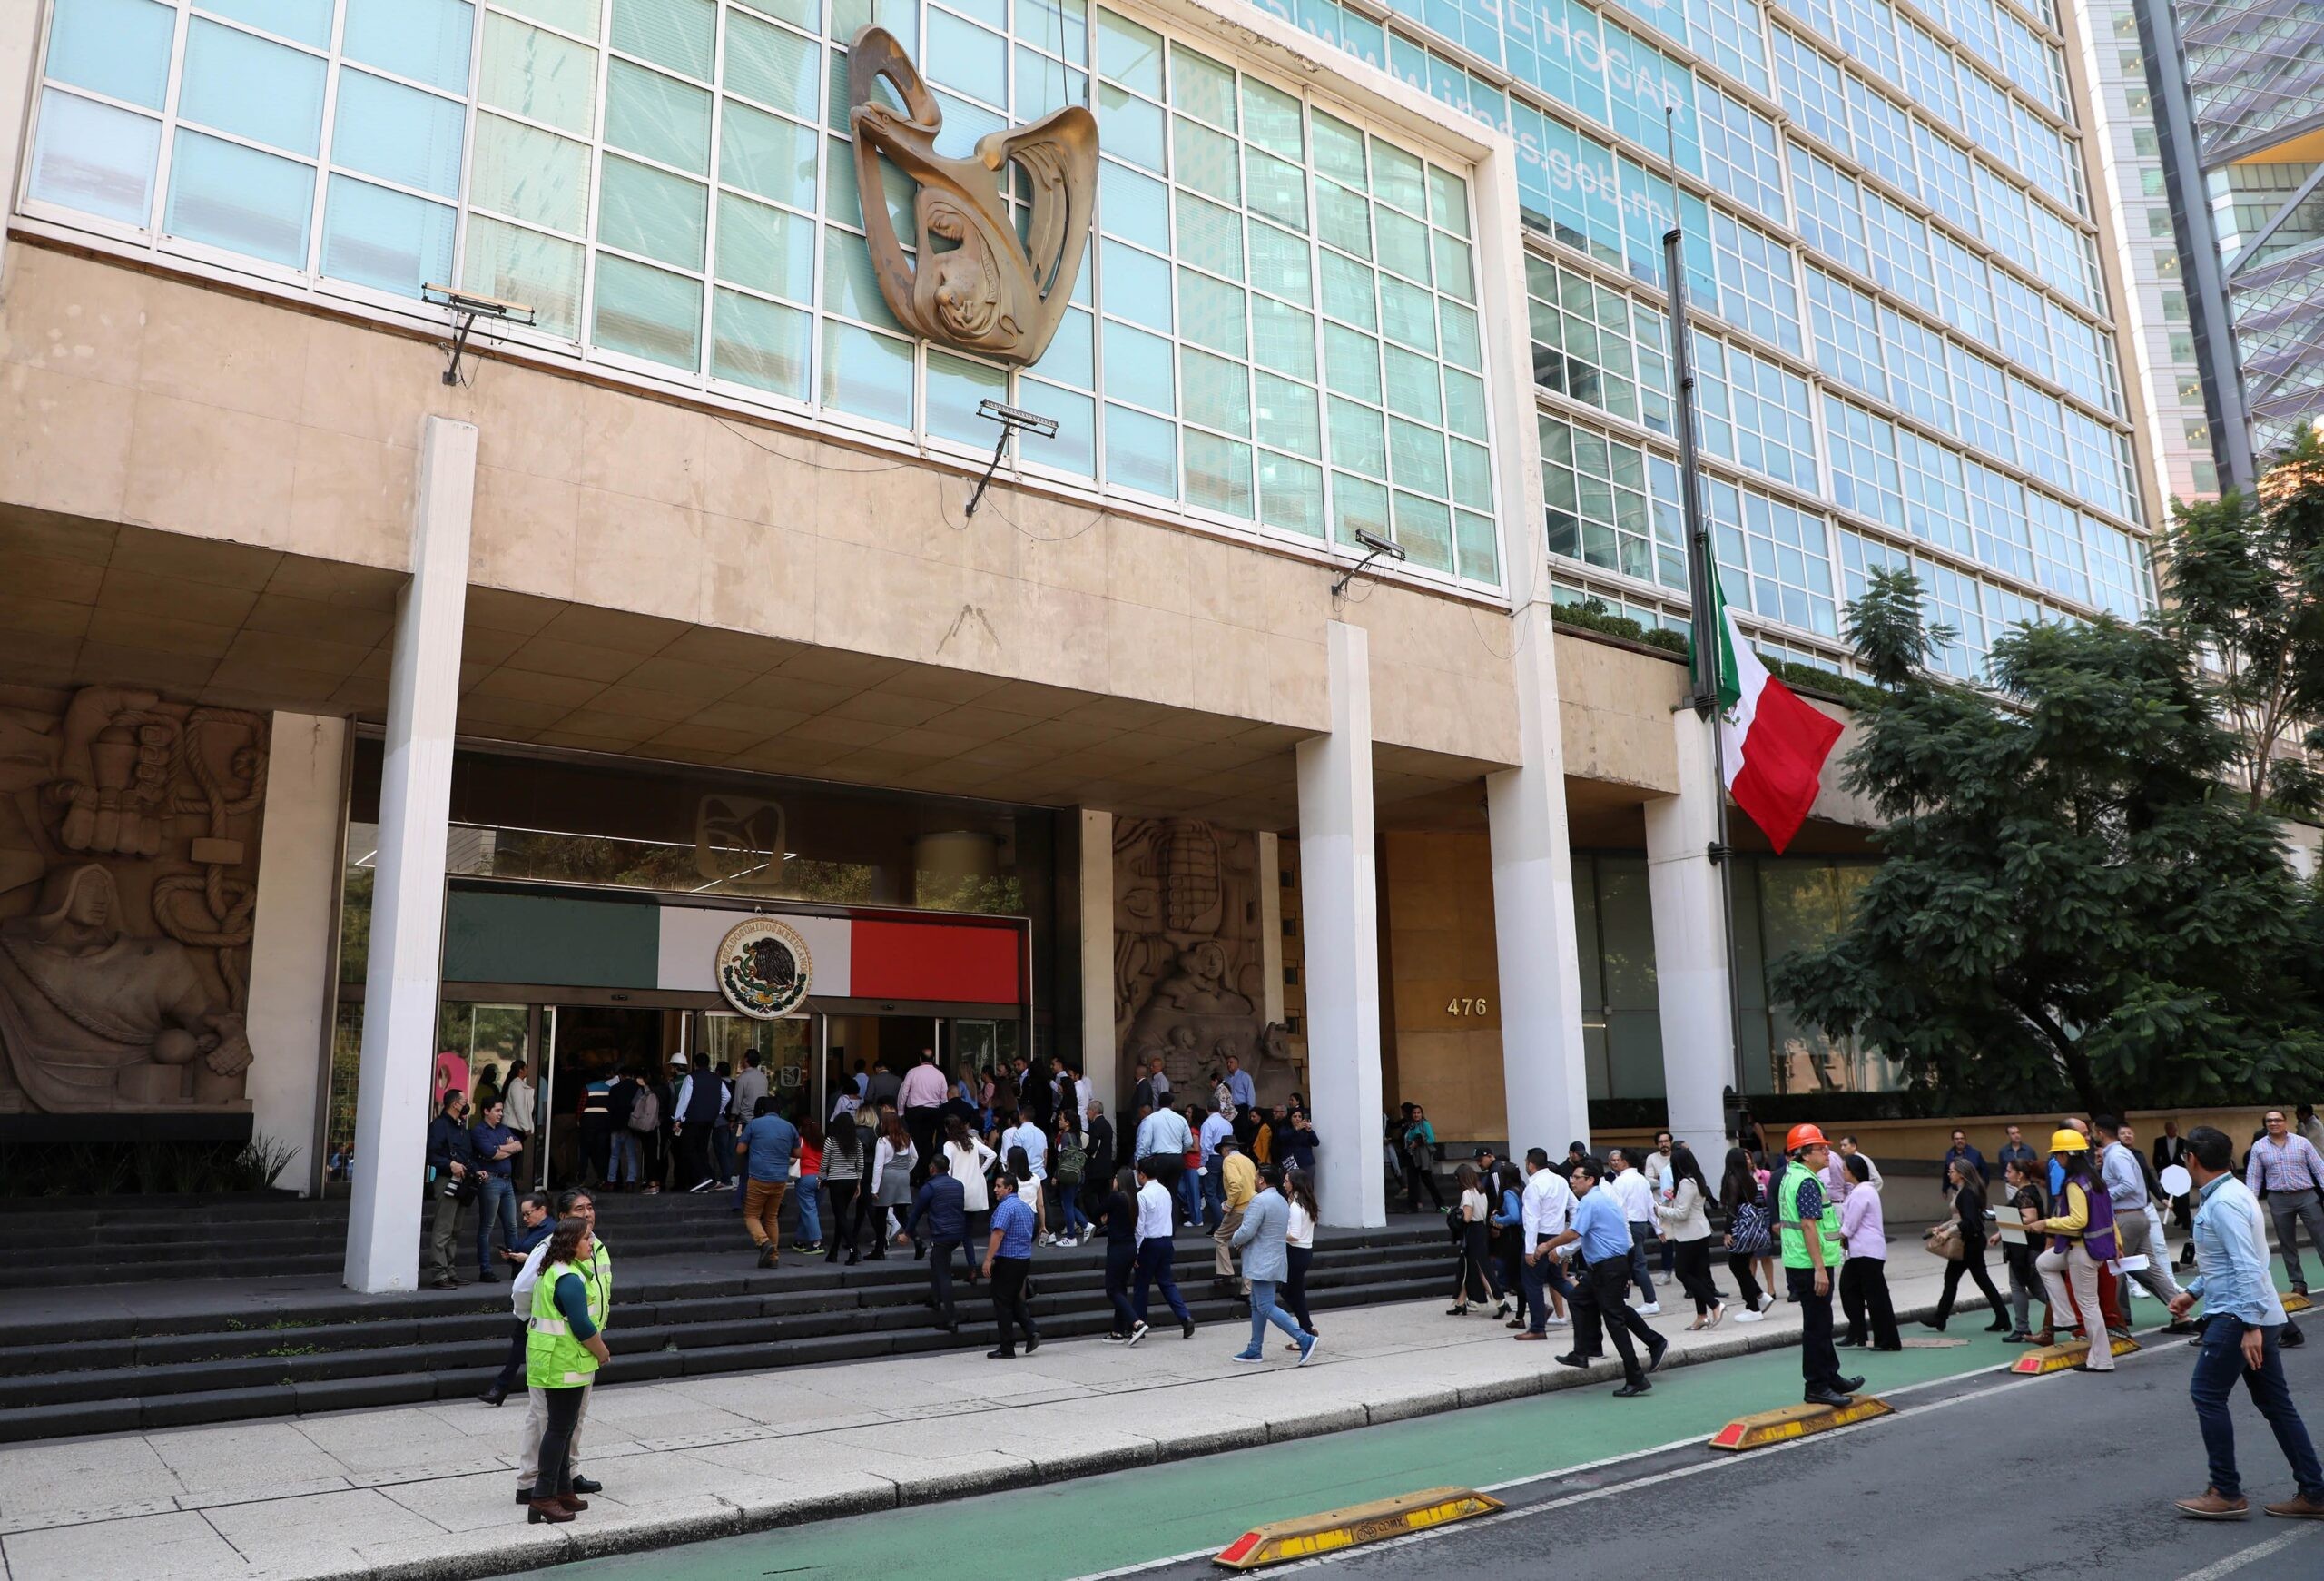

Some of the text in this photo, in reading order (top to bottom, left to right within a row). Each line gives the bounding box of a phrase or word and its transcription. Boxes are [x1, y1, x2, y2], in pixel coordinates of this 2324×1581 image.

[1542, 5, 1685, 124] HOGAR
[722, 928, 746, 964] ESTADOS
[743, 923, 777, 934] UNIDOS
[1447, 998, 1487, 1015] 476
[1379, 1517, 1404, 1532] CDMX
